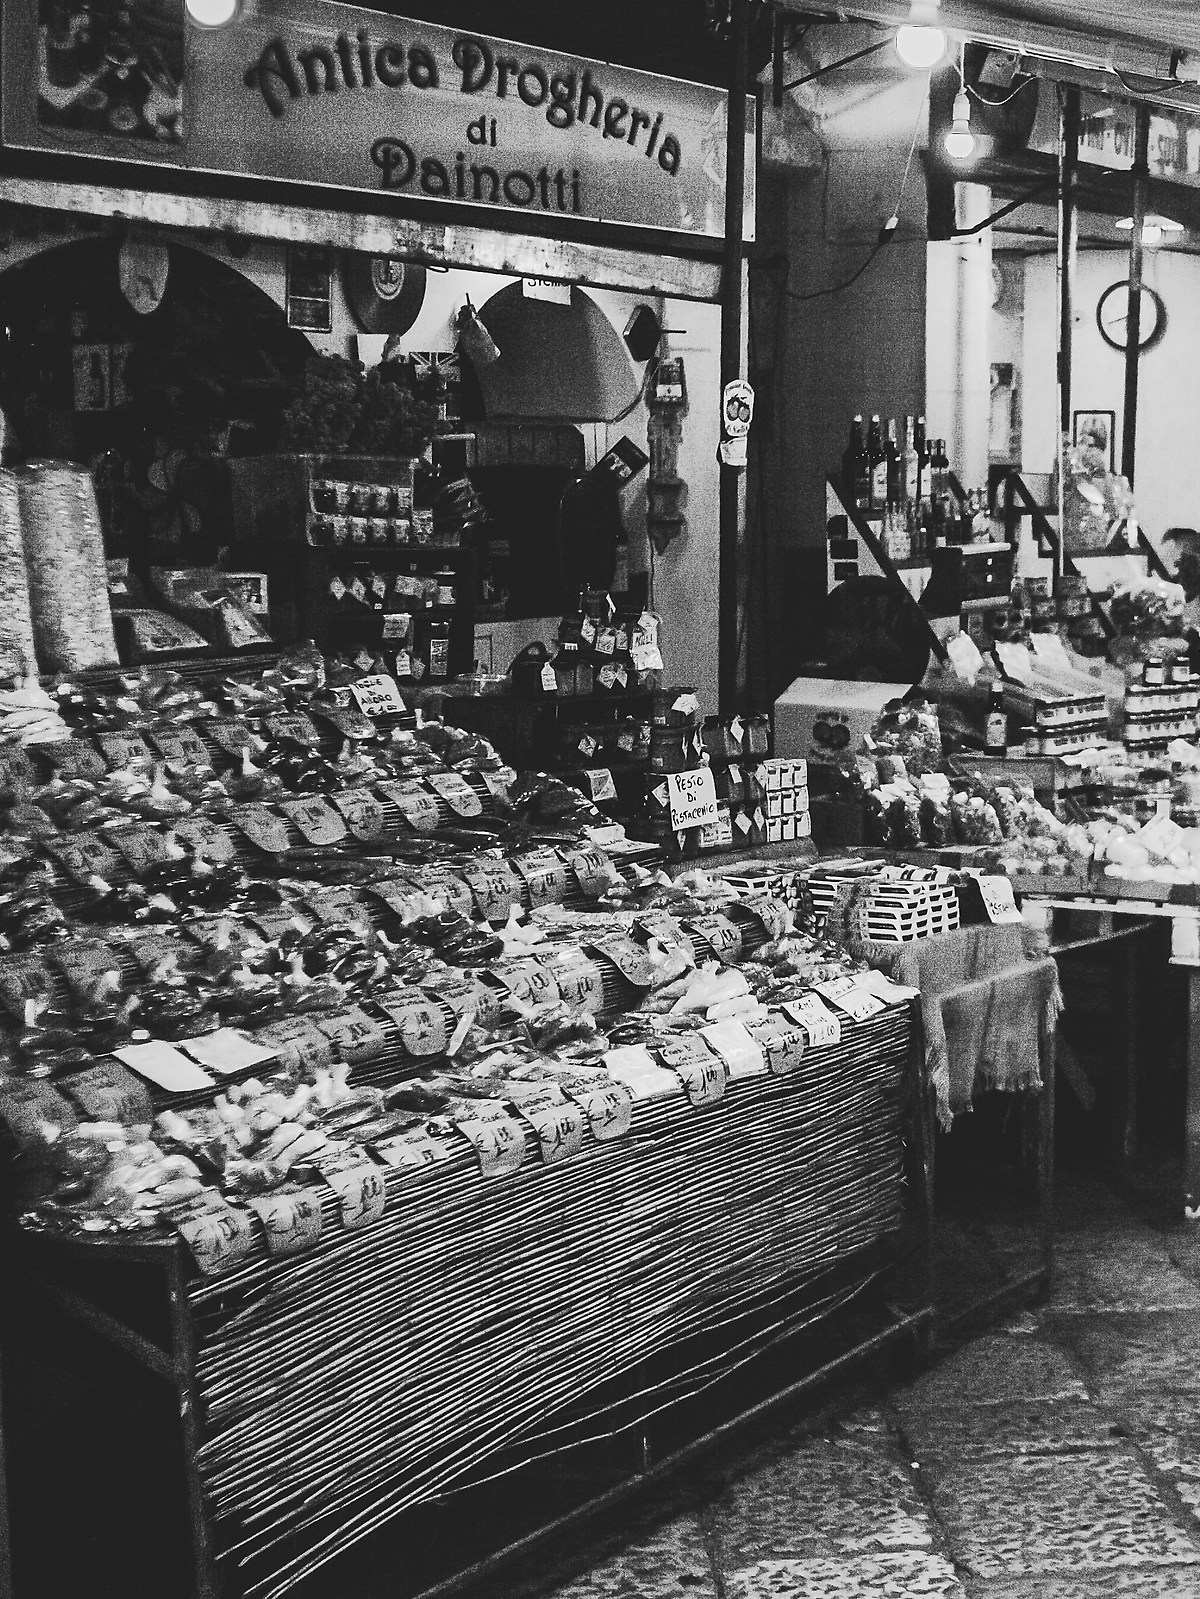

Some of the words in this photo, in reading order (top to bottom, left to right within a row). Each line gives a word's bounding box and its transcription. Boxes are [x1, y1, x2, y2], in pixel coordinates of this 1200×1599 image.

[243, 28, 438, 118] Antica
[451, 38, 681, 176] Drogheria
[466, 114, 497, 147] di
[370, 137, 580, 213] Dainotti
[674, 774, 704, 793] PESTO
